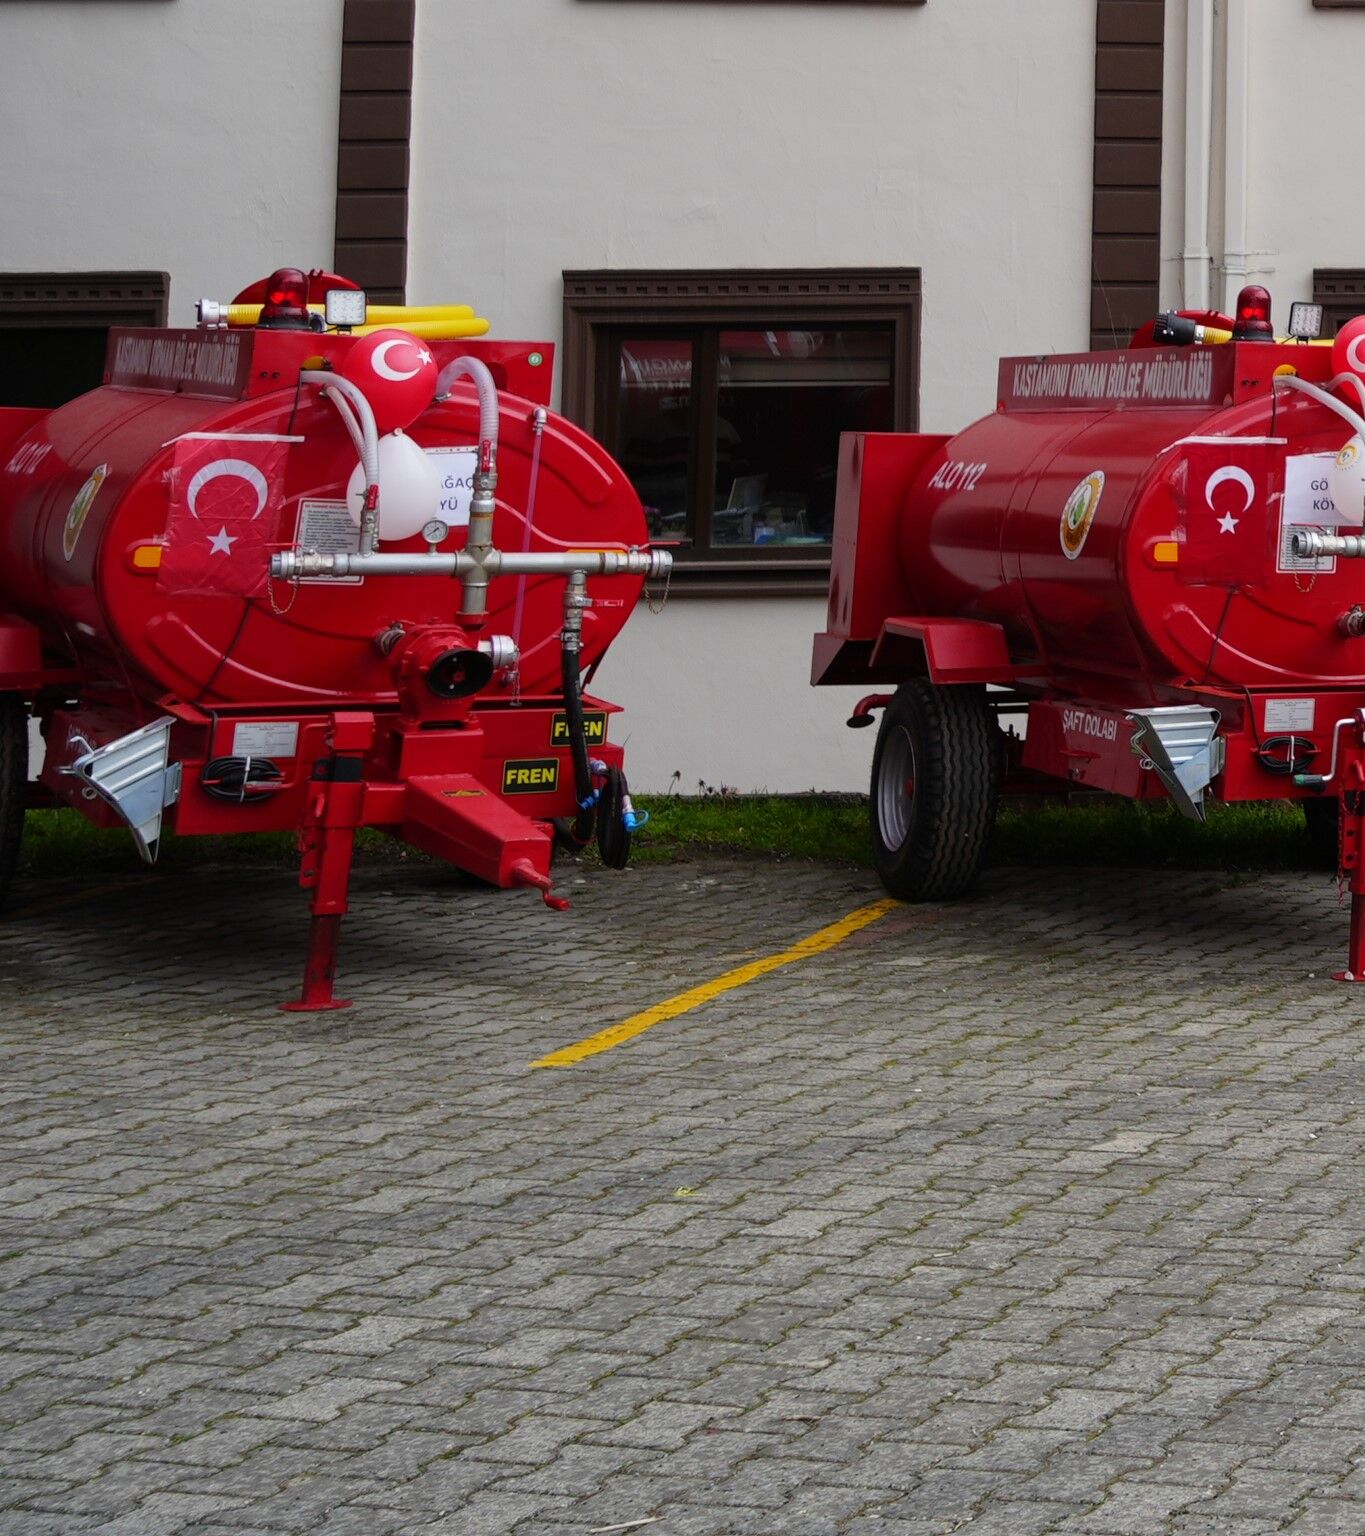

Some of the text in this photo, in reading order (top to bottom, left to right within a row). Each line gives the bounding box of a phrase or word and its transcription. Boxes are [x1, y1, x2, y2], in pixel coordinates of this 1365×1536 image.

[1012, 351, 1214, 401] KASTAMONU ORMAN BÖLGE MÜDÜRLÜĞÜ
[440, 475, 474, 491] ĞAÇ
[928, 460, 988, 492] ALO 112
[1313, 497, 1335, 511] KÖY
[1063, 709, 1119, 742] ŞAFT DOLABI
[505, 766, 555, 785] FREN
